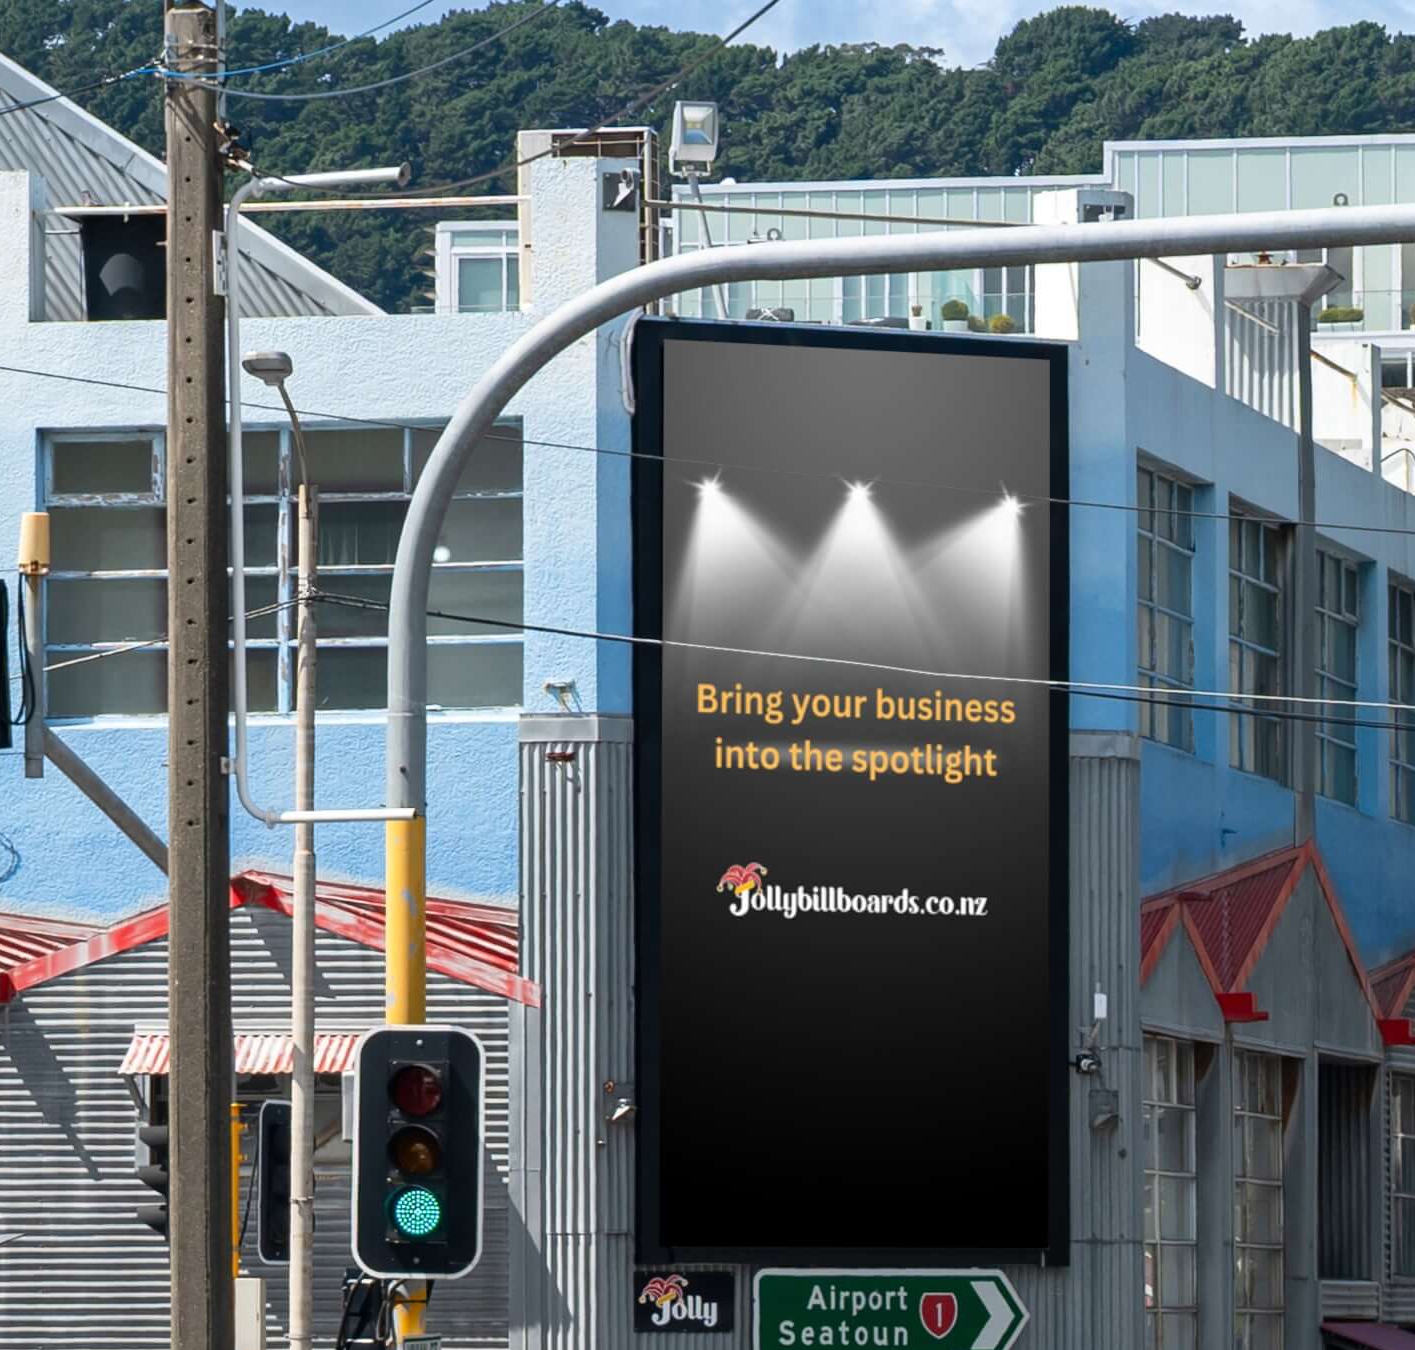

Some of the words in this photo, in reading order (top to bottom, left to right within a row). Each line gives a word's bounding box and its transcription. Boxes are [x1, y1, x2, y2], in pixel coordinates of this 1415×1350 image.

[697, 683, 783, 724] Bring
[791, 691, 867, 725] your
[876, 689, 1016, 724] business
[715, 737, 780, 770] into
[789, 740, 843, 771] the
[852, 744, 998, 783] spotlight
[729, 885, 988, 919] Jollybillboards.co.nz
[651, 1295, 718, 1327] Jolly
[807, 1285, 908, 1316] Airport
[936, 1302, 942, 1328] 1
[778, 1320, 908, 1346] Seatoun
